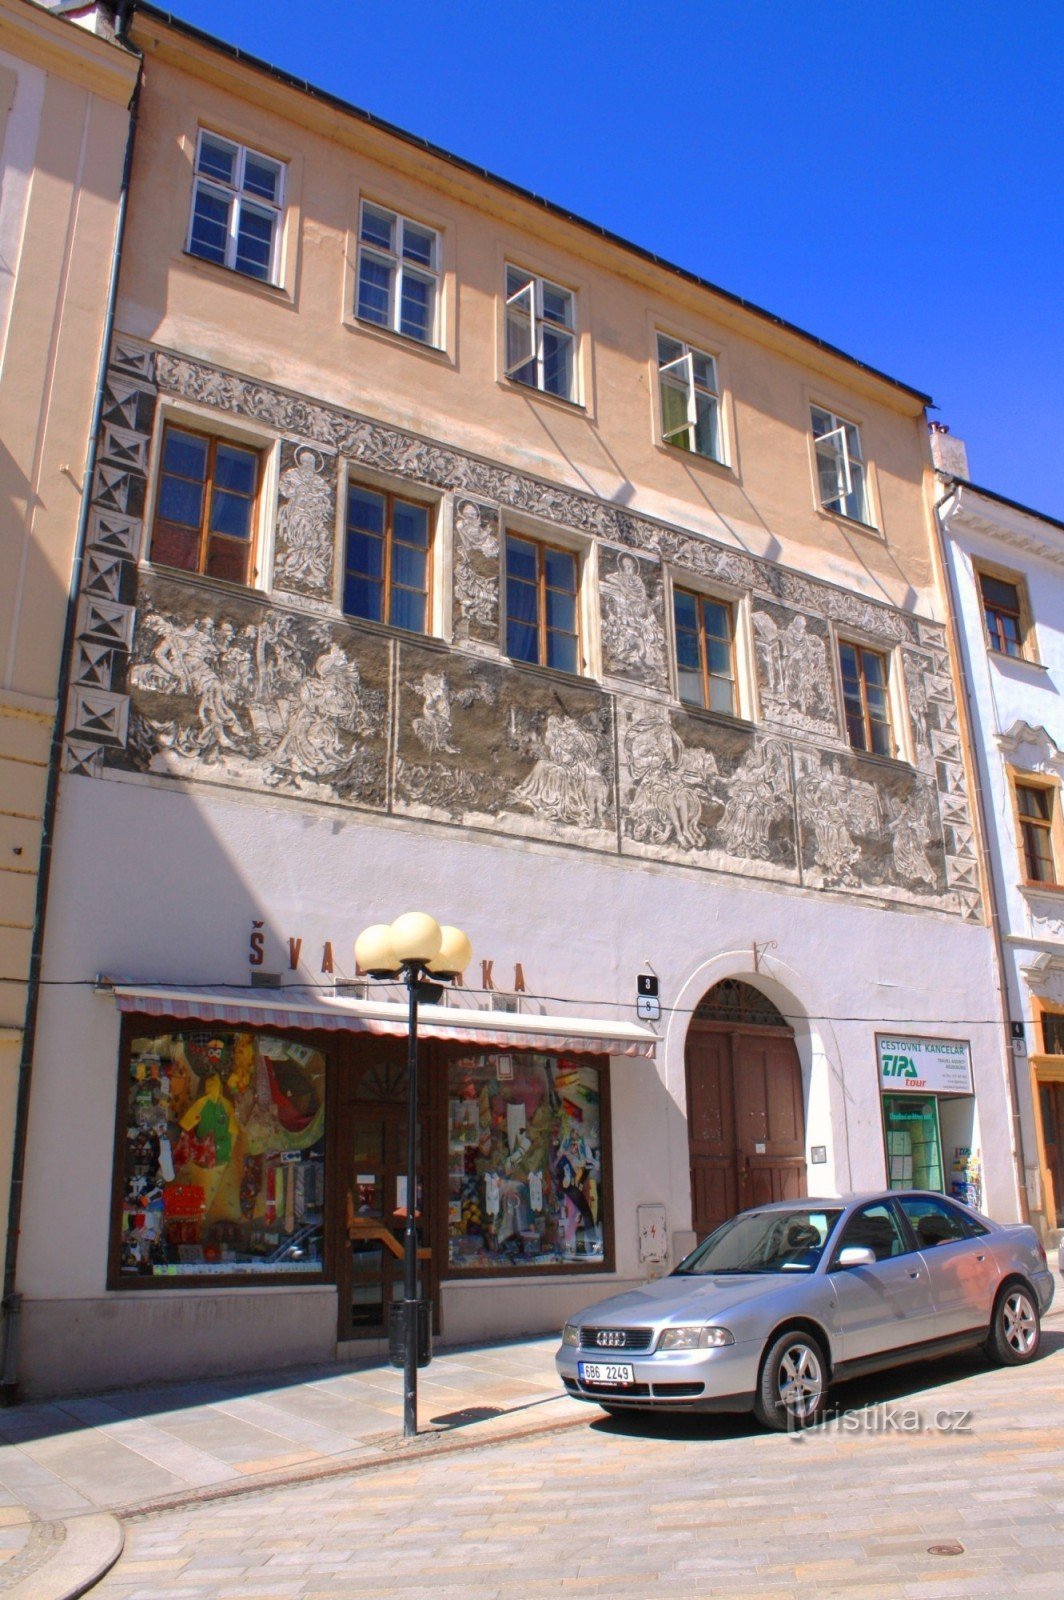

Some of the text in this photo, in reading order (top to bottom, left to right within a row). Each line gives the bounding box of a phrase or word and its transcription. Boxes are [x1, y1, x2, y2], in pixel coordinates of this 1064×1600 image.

[880, 1040, 965, 1056] CESTOVNÍ KANCELÁŘ
[882, 1054, 918, 1078] TIPA
[905, 1079, 927, 1087] tour
[585, 1365, 629, 1380] 6B6 2249
